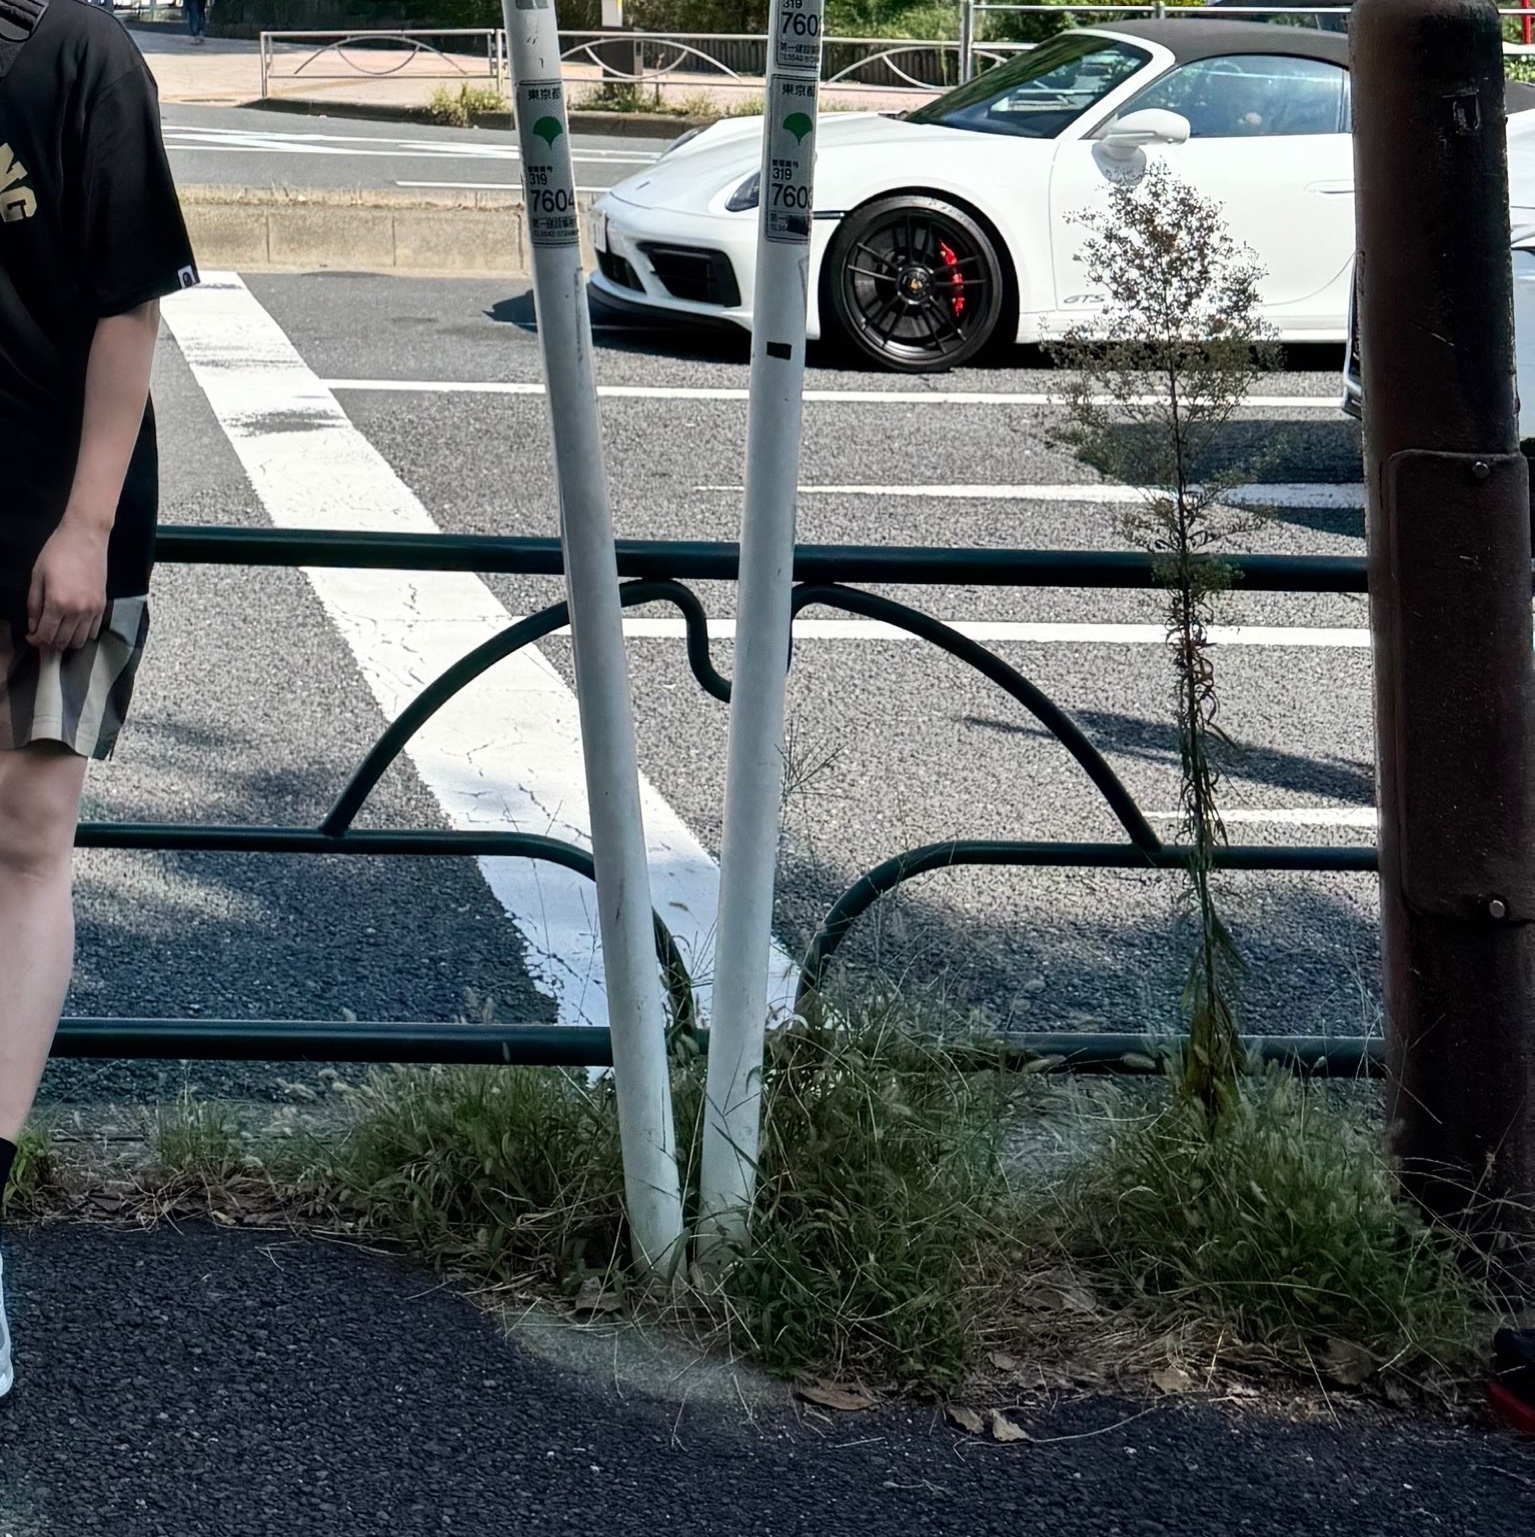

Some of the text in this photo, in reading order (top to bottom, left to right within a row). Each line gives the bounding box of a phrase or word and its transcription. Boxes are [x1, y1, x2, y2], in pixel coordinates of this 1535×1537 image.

[529, 173, 548, 185] 319
[772, 168, 793, 181] 319
[1063, 294, 1105, 304] GTS
